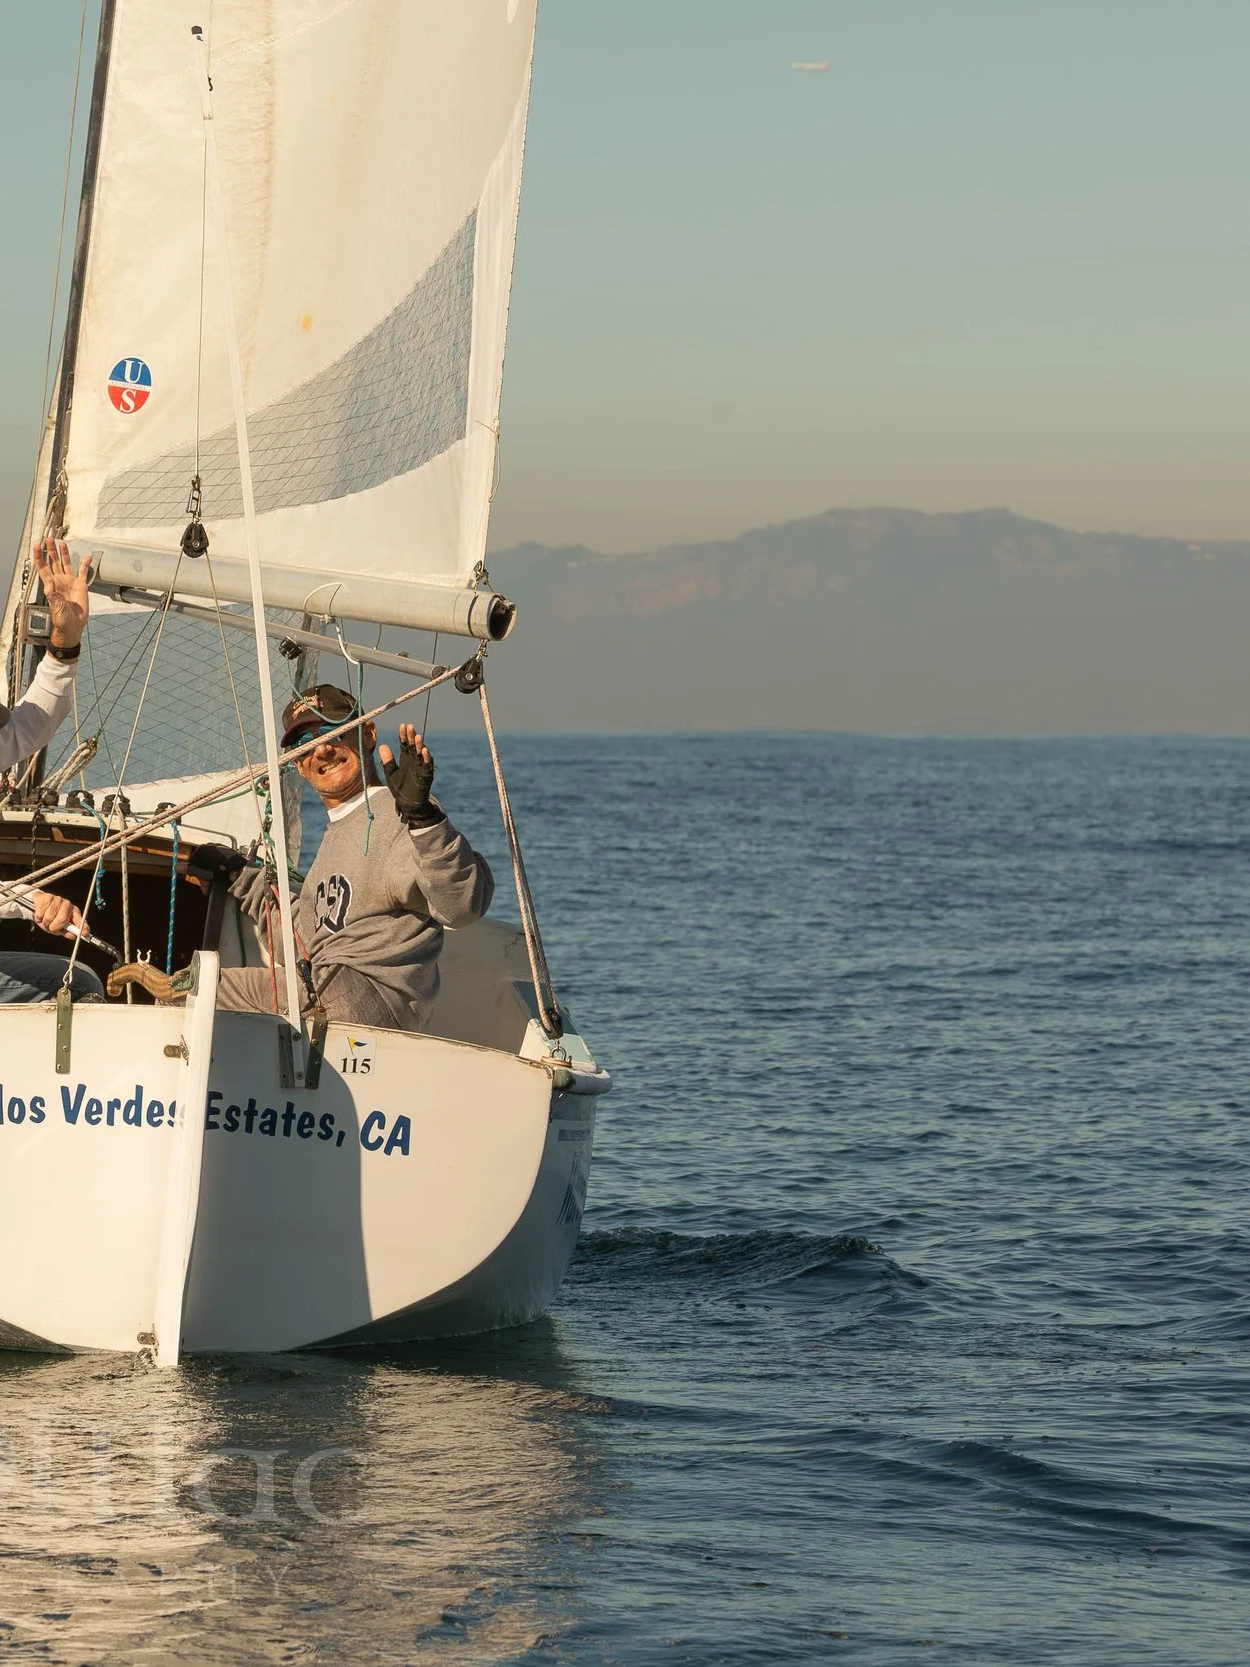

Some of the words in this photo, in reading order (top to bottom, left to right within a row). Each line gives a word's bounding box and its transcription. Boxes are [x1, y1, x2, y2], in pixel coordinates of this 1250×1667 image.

[341, 1057, 372, 1075] 115
[205, 1091, 346, 1148] Estates,
[359, 1110, 412, 1157] CA
